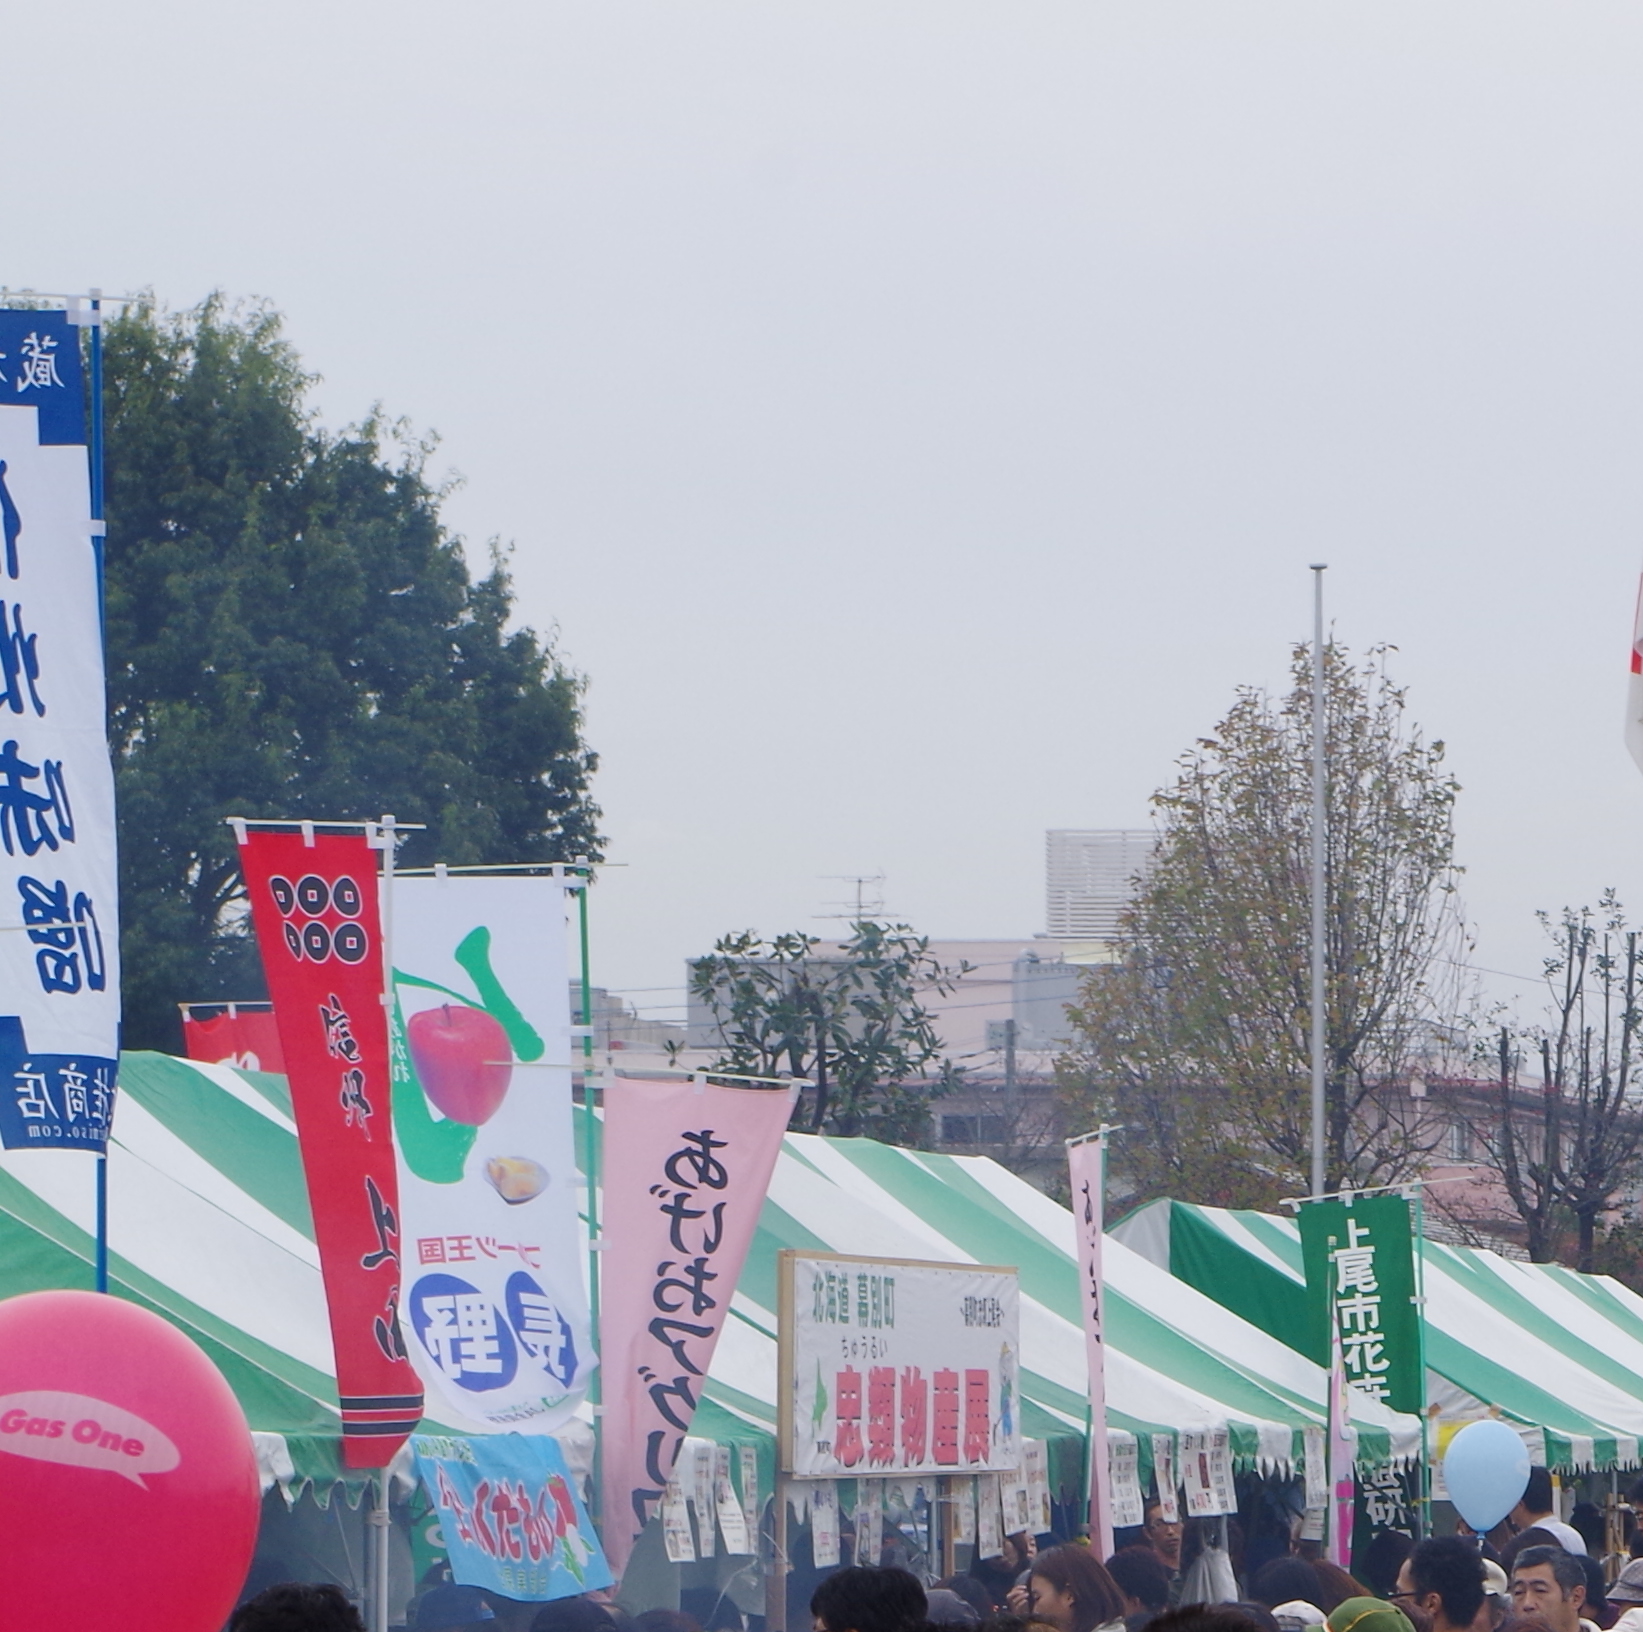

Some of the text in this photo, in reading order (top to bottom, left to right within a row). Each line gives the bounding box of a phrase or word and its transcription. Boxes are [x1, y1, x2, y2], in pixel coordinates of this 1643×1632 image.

[812, 1271, 849, 1324] 北海道
[856, 1272, 895, 1328] 幕別町
[841, 1335, 888, 1359] ちゅうるい
[0, 1408, 145, 1457] Gas One
[834, 1363, 990, 1468] 忠類物産展
